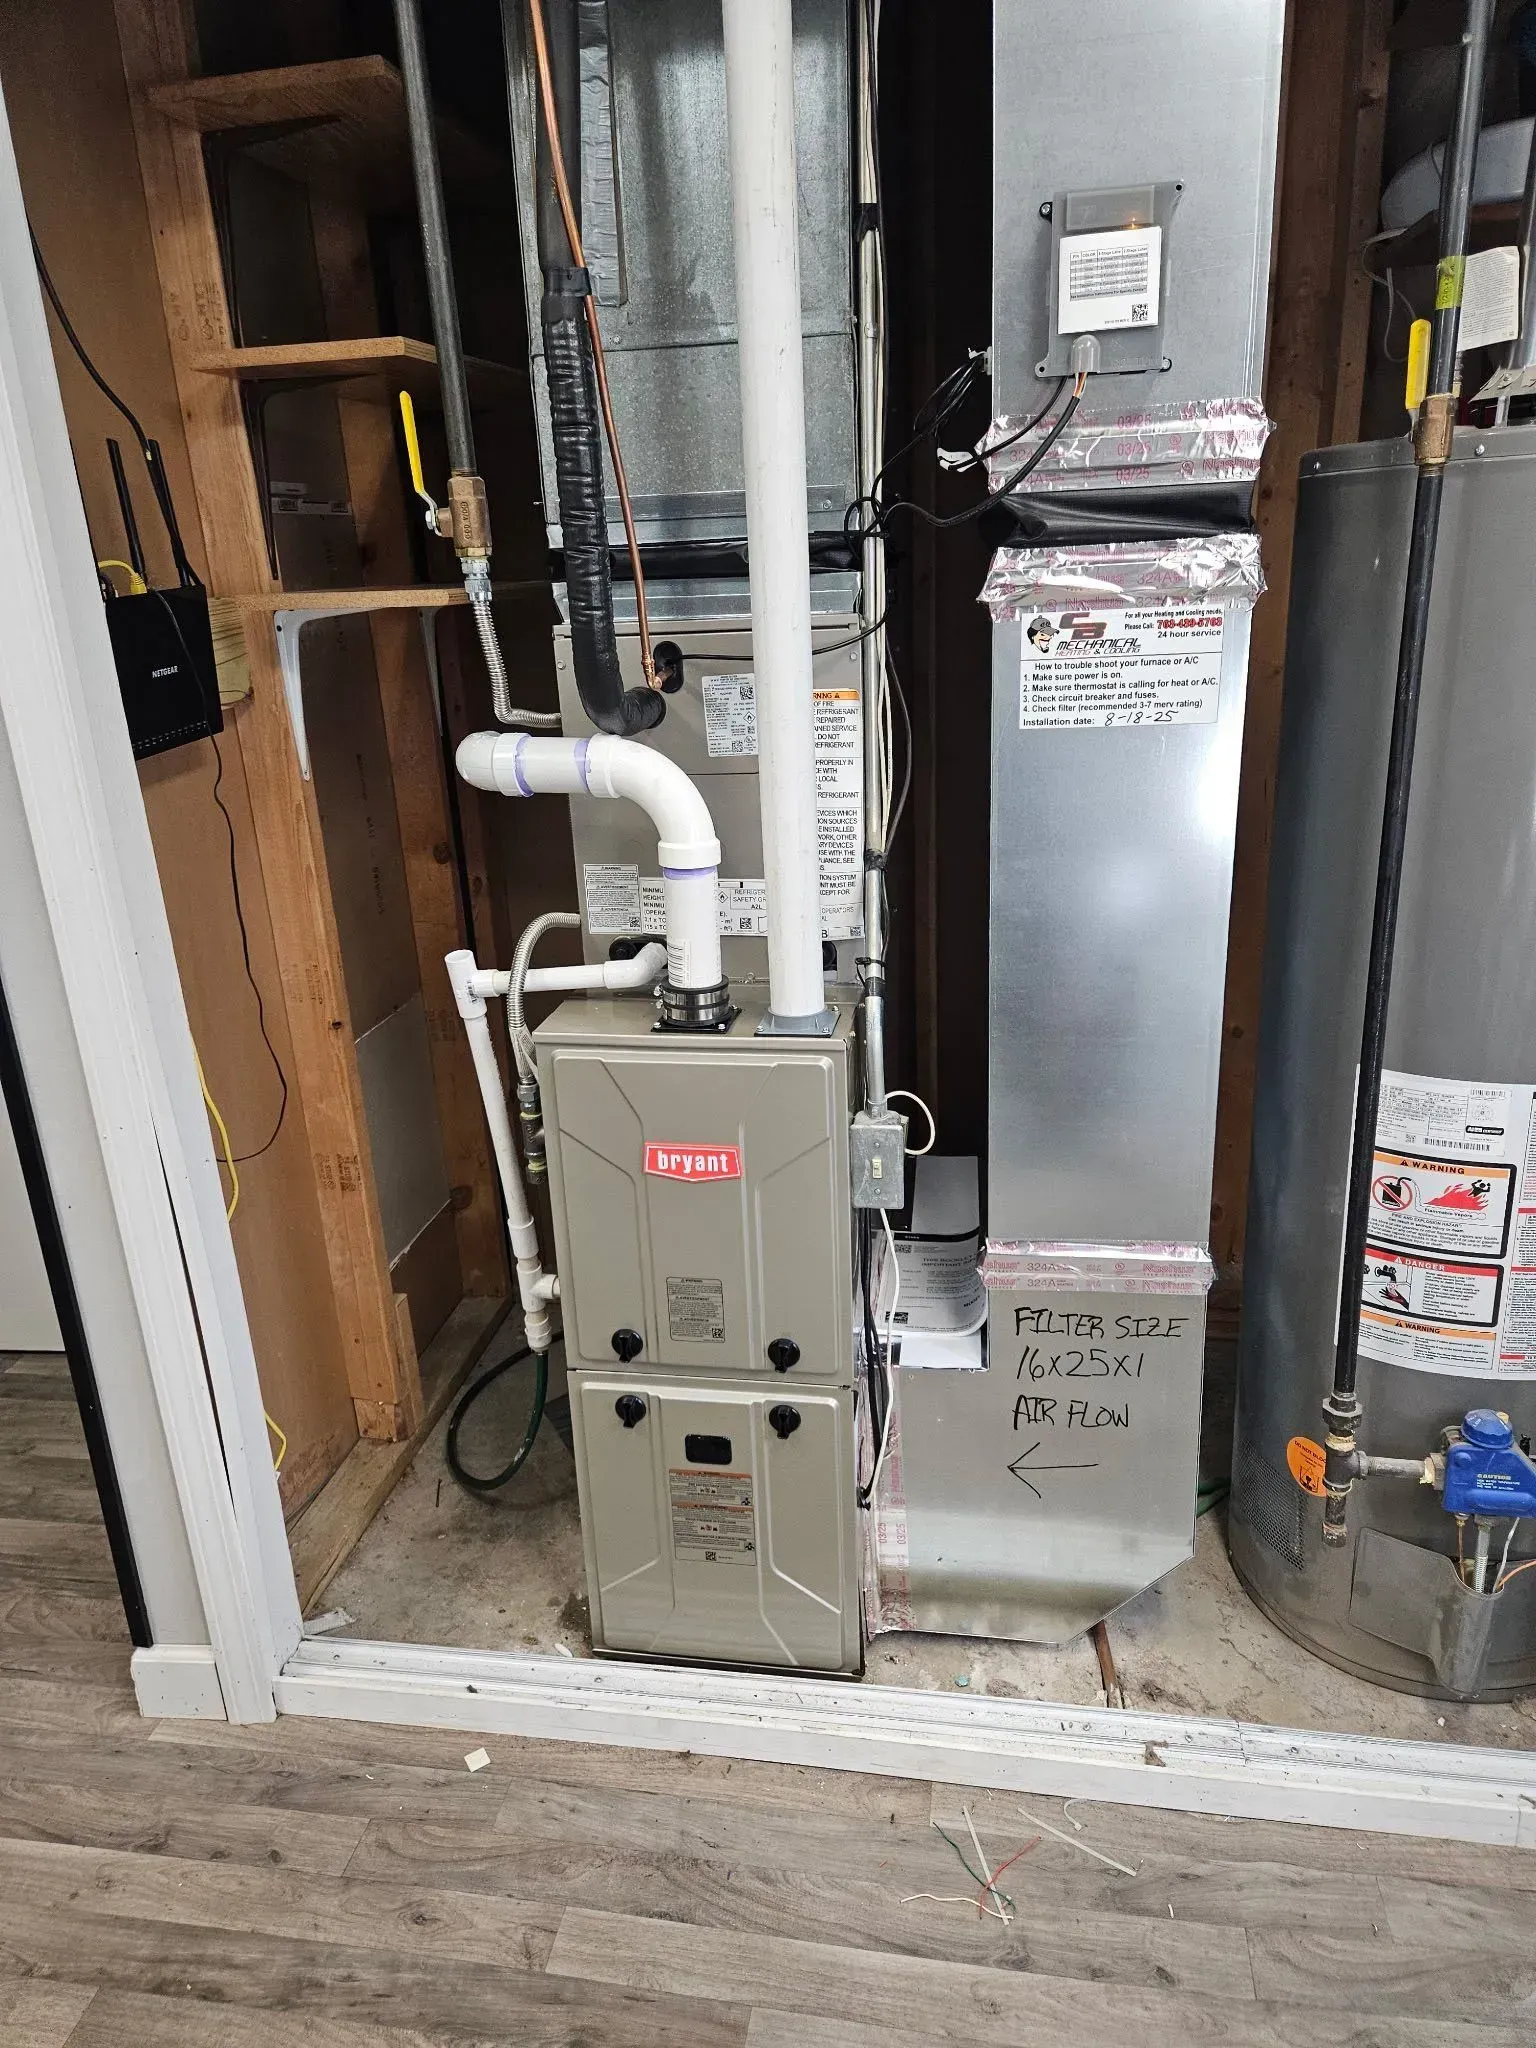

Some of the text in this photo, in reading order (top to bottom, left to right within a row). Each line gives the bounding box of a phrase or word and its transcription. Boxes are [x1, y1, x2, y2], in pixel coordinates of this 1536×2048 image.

[1116, 467, 1150, 481] 03/25
[1065, 597, 1124, 610] Nashua
[1154, 610, 1174, 618] Heating
[1186, 608, 1205, 616] Cooling
[1157, 629, 1221, 638] 24 hour service
[1056, 638, 1142, 650] MECHANICAL
[1034, 662, 1052, 671] How
[1054, 662, 1063, 670] to
[1064, 661, 1092, 669] trouble
[1094, 660, 1118, 668] shoot
[1120, 659, 1138, 669] your
[1140, 658, 1172, 666] furnace
[1184, 656, 1199, 665] A/C
[151, 664, 179, 679] NETGEAR
[1032, 673, 1053, 681] Make
[1074, 672, 1099, 681] power
[1101, 671, 1108, 679] is
[1023, 684, 1030, 692] 2.
[1031, 683, 1053, 692] Make
[1054, 684, 1072, 692] sure
[1074, 682, 1117, 691] thermostat
[1119, 681, 1126, 689] is
[1128, 680, 1156, 689] calling
[1157, 679, 1169, 687] for
[1171, 678, 1189, 687] heat
[1201, 677, 1218, 686] A/C.
[1023, 691, 1159, 703] 3. Check circuit breaker and fuses.
[1023, 705, 1030, 713] 4.
[1031, 704, 1057, 712] Check
[1058, 703, 1076, 712] filter
[1078, 702, 1138, 712] (recommended
[1139, 701, 1152, 709] 3-7
[1176, 699, 1203, 709] rating)
[815, 716, 846, 724] REPAIRED
[1023, 717, 1095, 726] Installation date:
[1104, 710, 1179, 727] 8-18-25
[817, 791, 860, 799] REFRIGERANT
[657, 1150, 729, 1174] bryant
[1412, 1161, 1466, 1175] WARNING
[1026, 1262, 1057, 1272] 324A
[1142, 1263, 1195, 1275] Nashua
[1405, 1258, 1446, 1272] DANGER
[1026, 1278, 1057, 1288] 324A
[1142, 1279, 1193, 1291] Nashua
[1013, 1306, 1190, 1340] FILTER SIZE
[1404, 1322, 1442, 1334] WARNING
[1012, 1394, 1130, 1431] AIR FLOW
